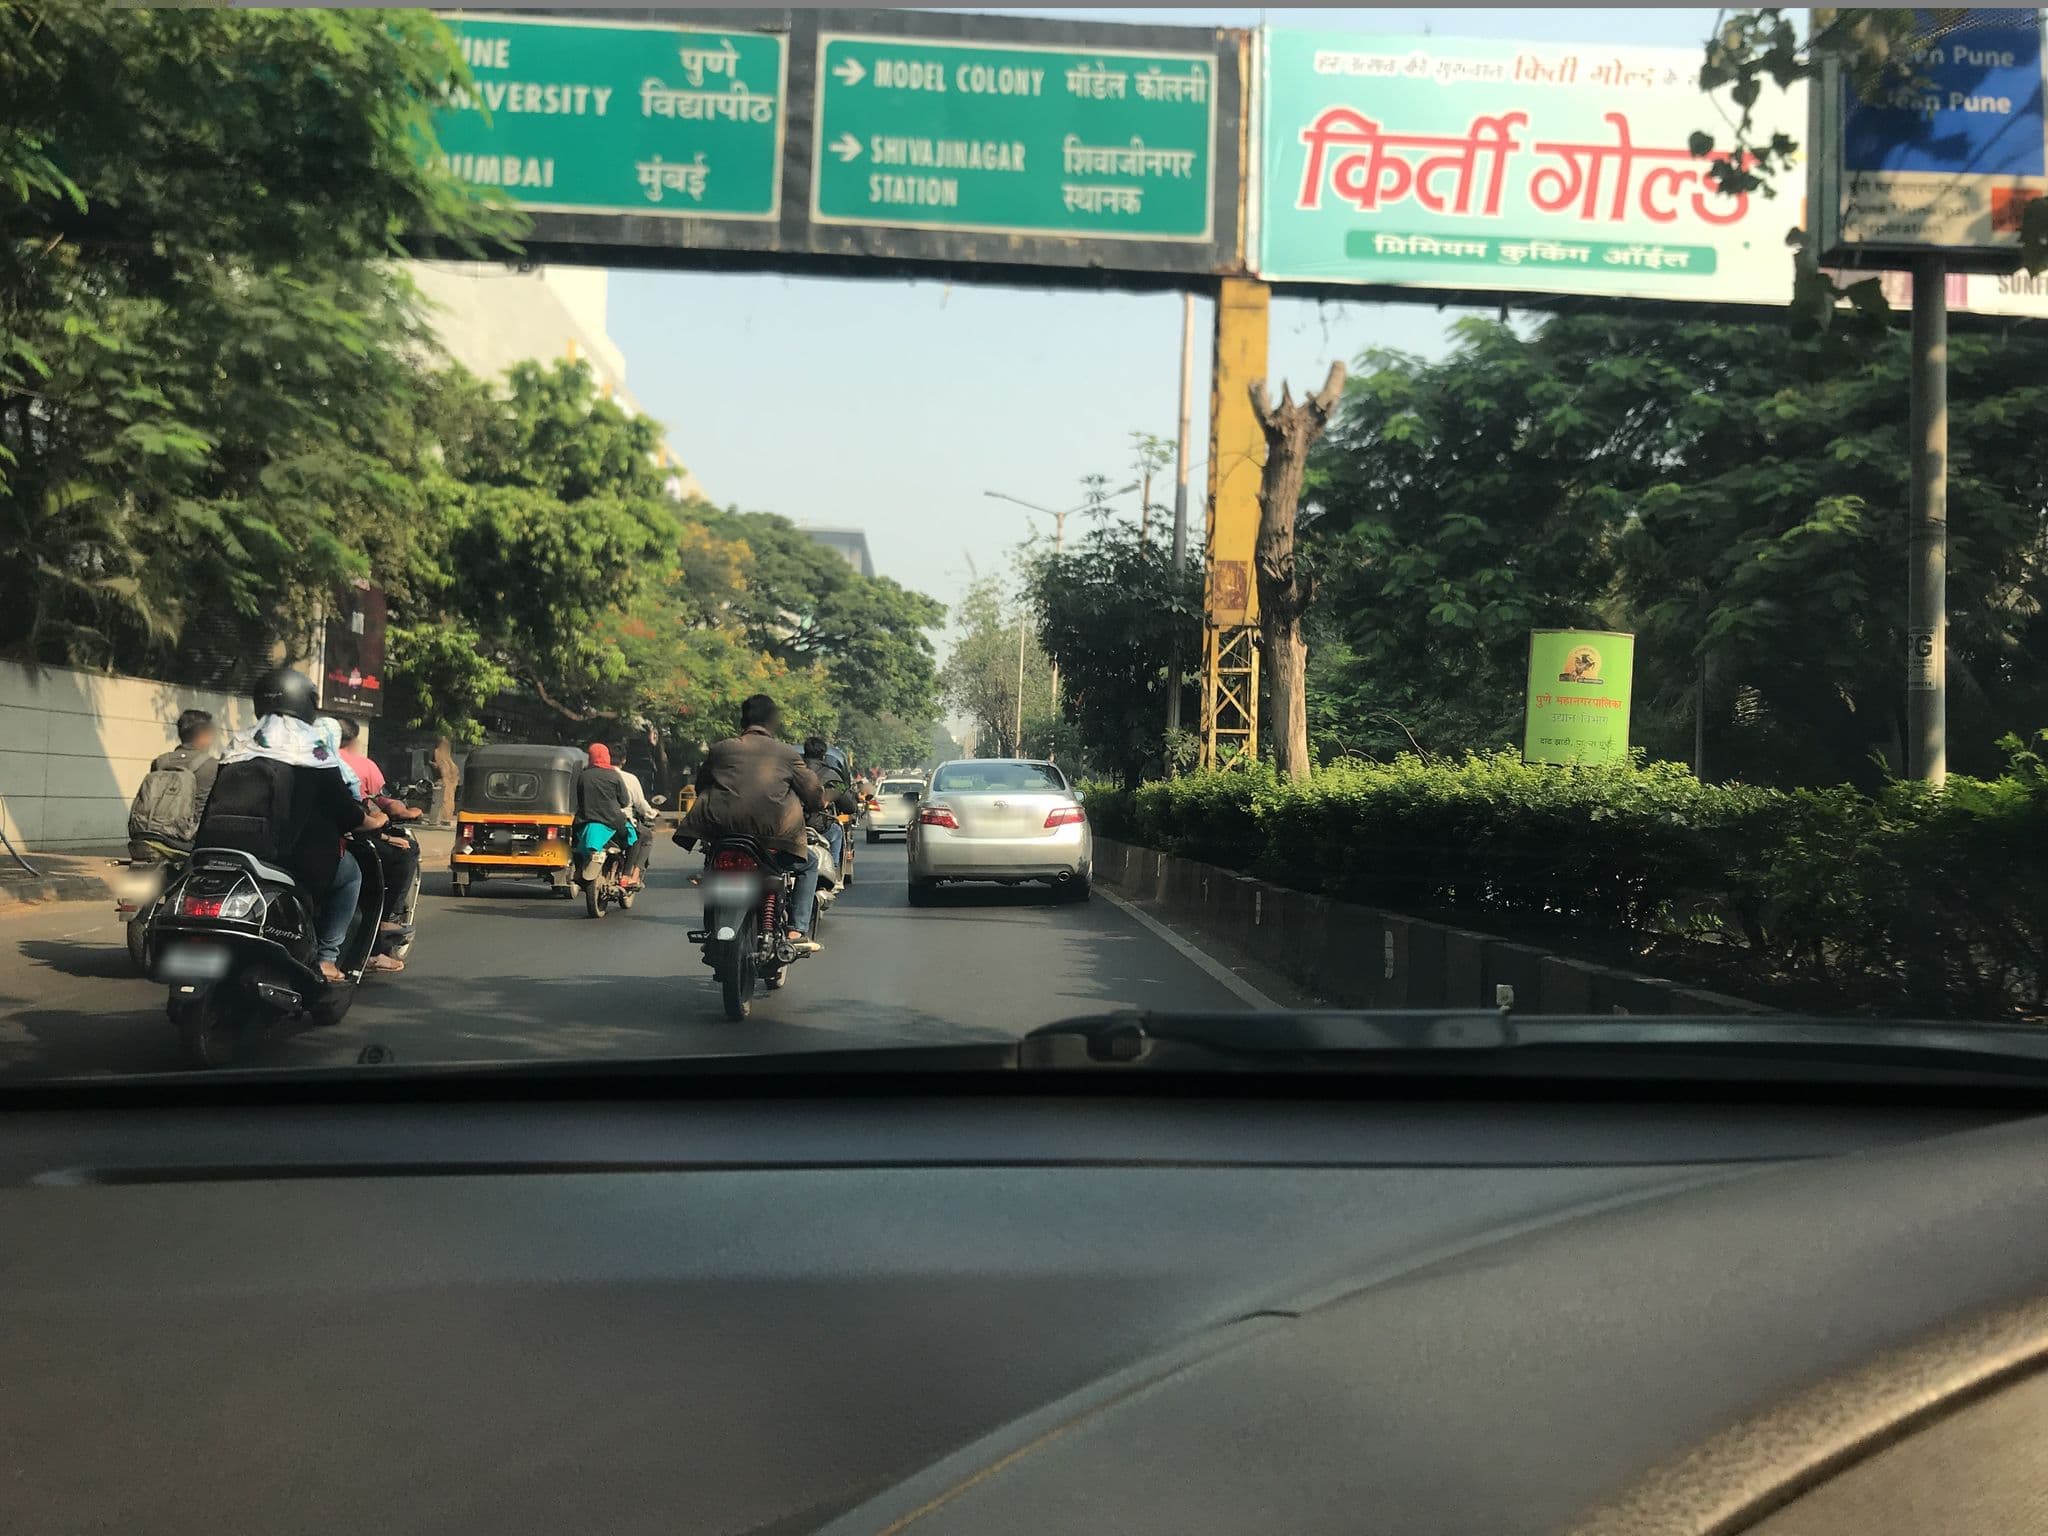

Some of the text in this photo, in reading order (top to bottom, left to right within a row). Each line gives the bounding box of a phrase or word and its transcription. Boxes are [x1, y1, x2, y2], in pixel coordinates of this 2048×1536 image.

[680, 39, 740, 87] पुणे
[1953, 45, 2015, 68] Pune
[873, 59, 1045, 97] MODEL COLONY
[1065, 61, 1208, 103] मॉडेल कॉलनी
[640, 78, 774, 123] विद्यापीठ
[1949, 92, 2012, 113] Pune
[869, 134, 1026, 172] SHIVAJINAGAR
[1062, 135, 1197, 180] शिवाजीनगर
[1299, 107, 1527, 216] किर्ती
[636, 153, 709, 200] मुंबई
[868, 174, 958, 207] STATION
[1062, 184, 1143, 214] स्थानक
[1603, 246, 1690, 271] ऑईल
